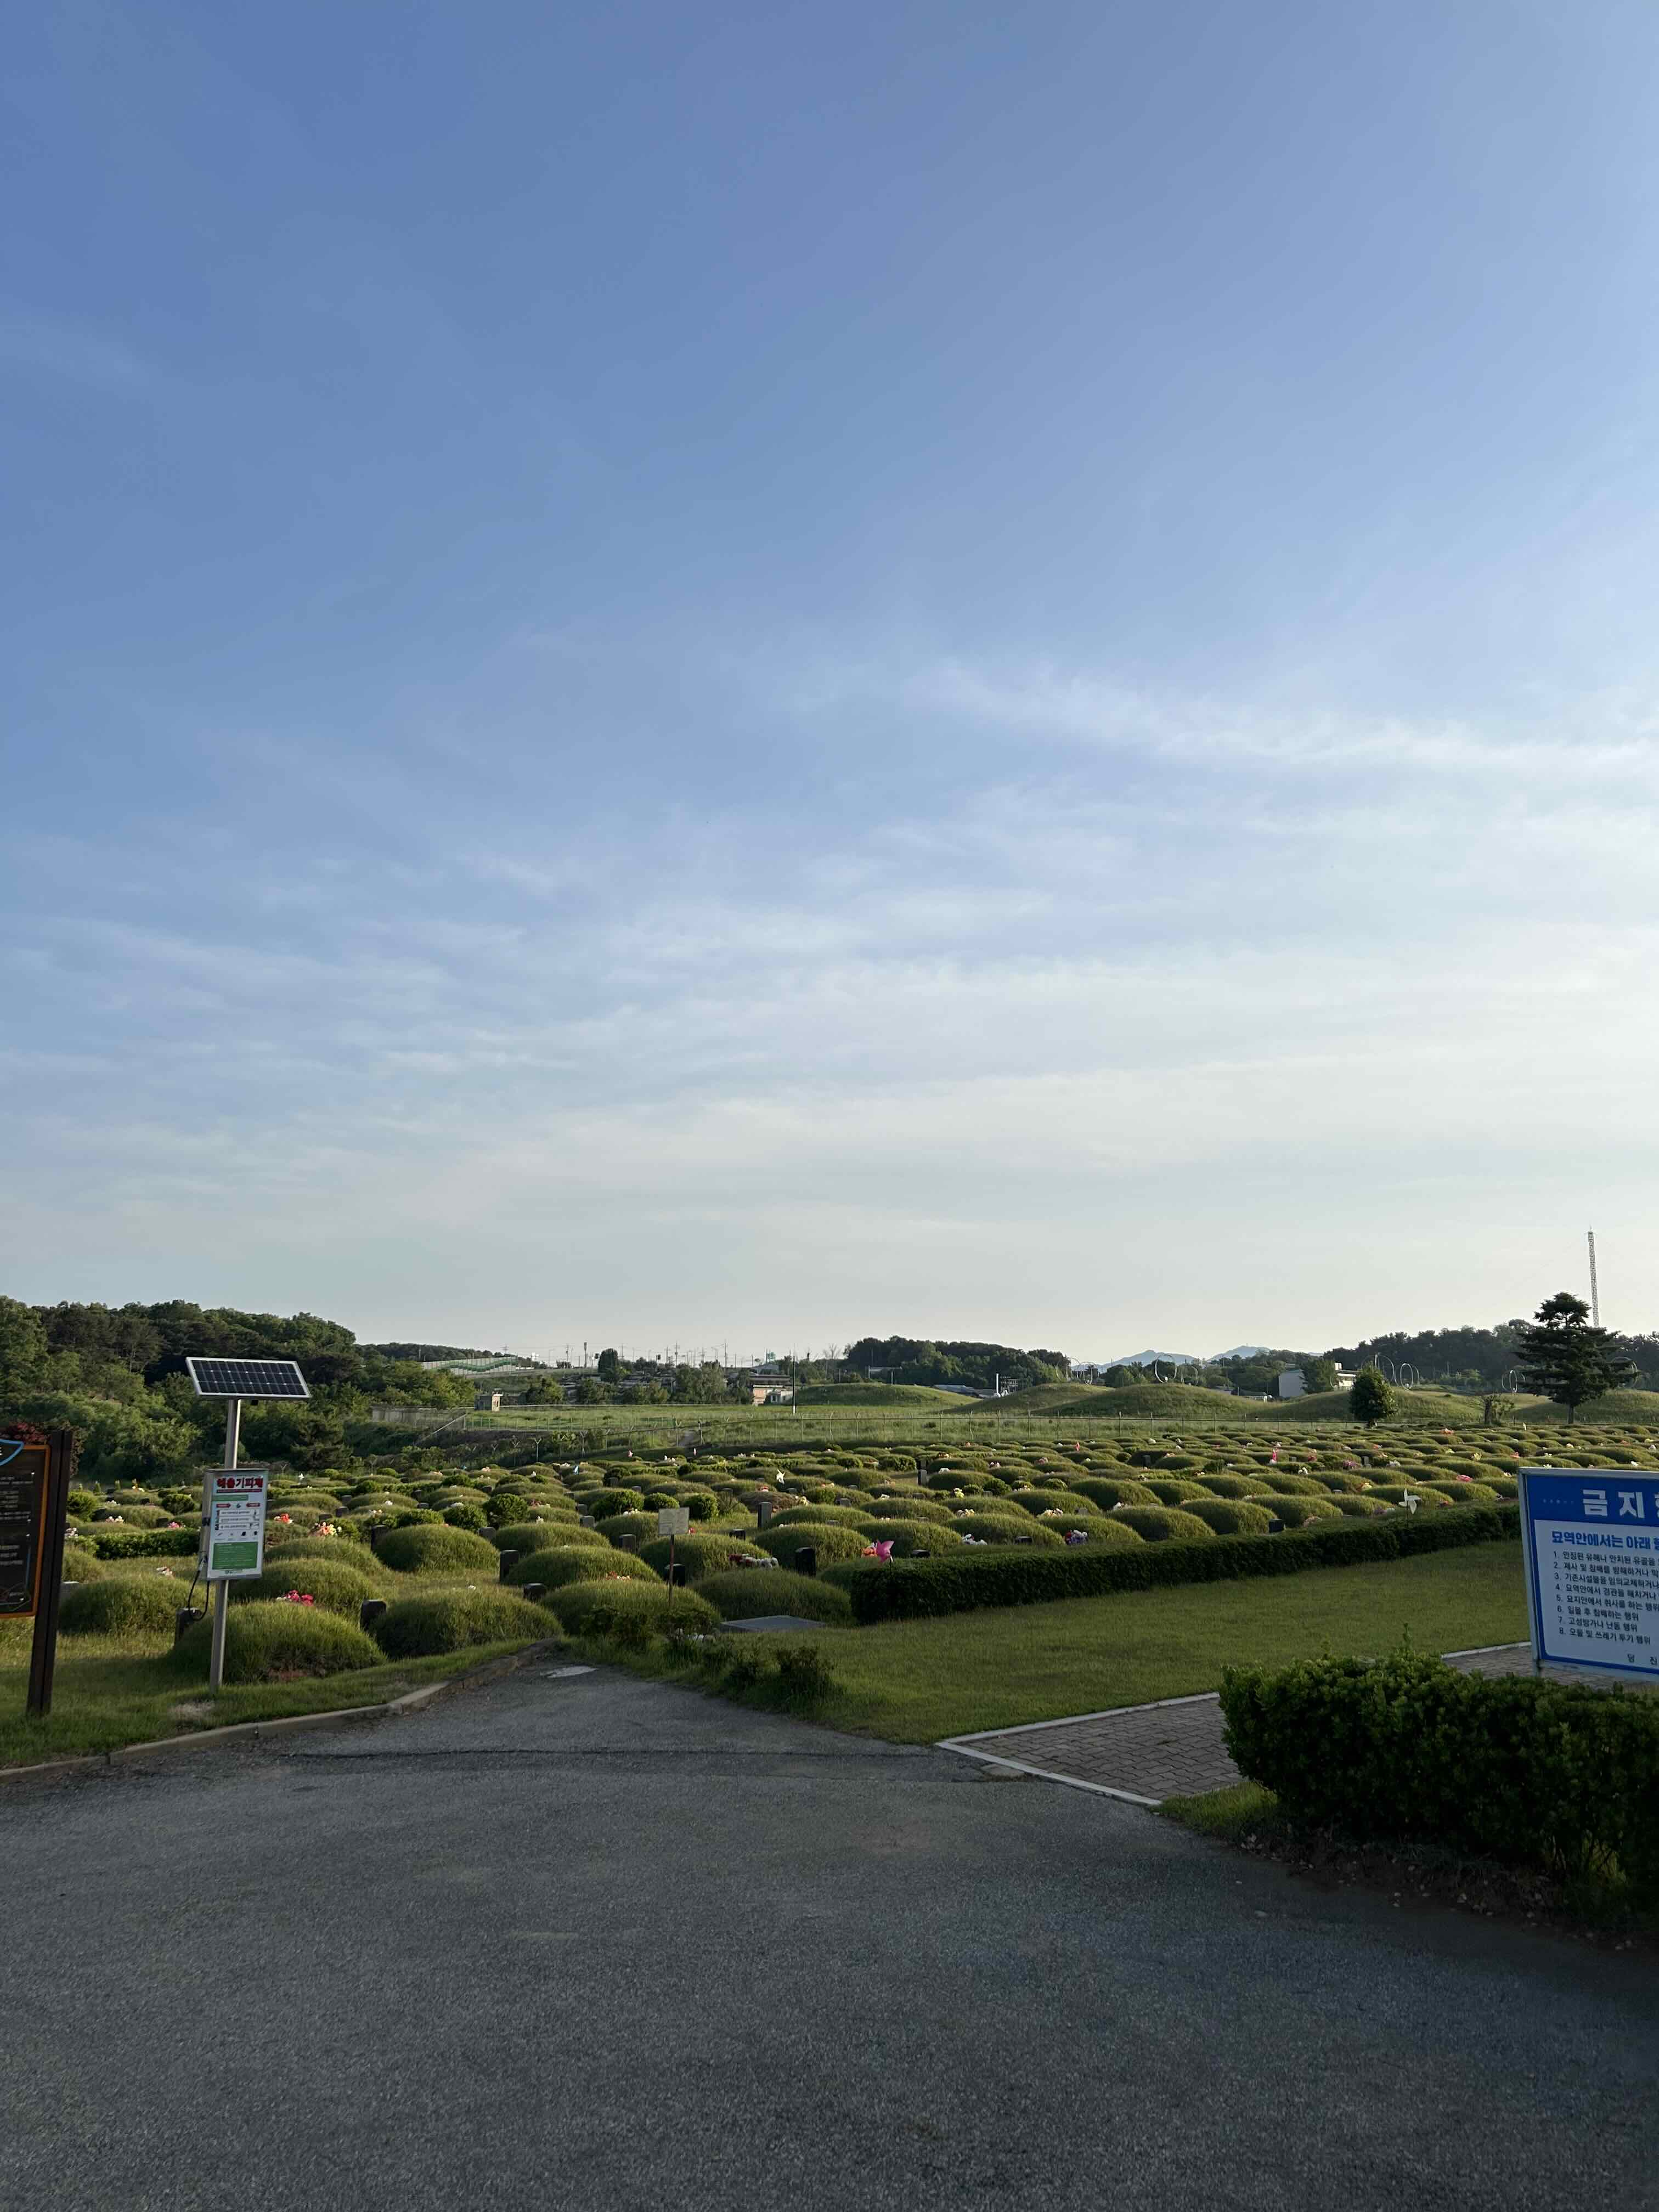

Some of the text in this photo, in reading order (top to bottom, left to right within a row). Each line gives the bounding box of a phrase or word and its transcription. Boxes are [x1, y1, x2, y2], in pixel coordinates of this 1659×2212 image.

[1583, 1489, 1659, 1519] 금지
[1552, 1531, 1623, 1548] 묘역안에서는
[1626, 1536, 1651, 1550] 아래
[1563, 1551, 1584, 1560] 안장된
[1609, 1555, 1631, 1564] 안치된
[1564, 1562, 1577, 1571] 제사
[1566, 1584, 1601, 1595] 묘역안에서
[1567, 1595, 1601, 1606] 묘지안에서
[1628, 1601, 1643, 1610] 하는
[1595, 1631, 1617, 1641] 쓰레기
